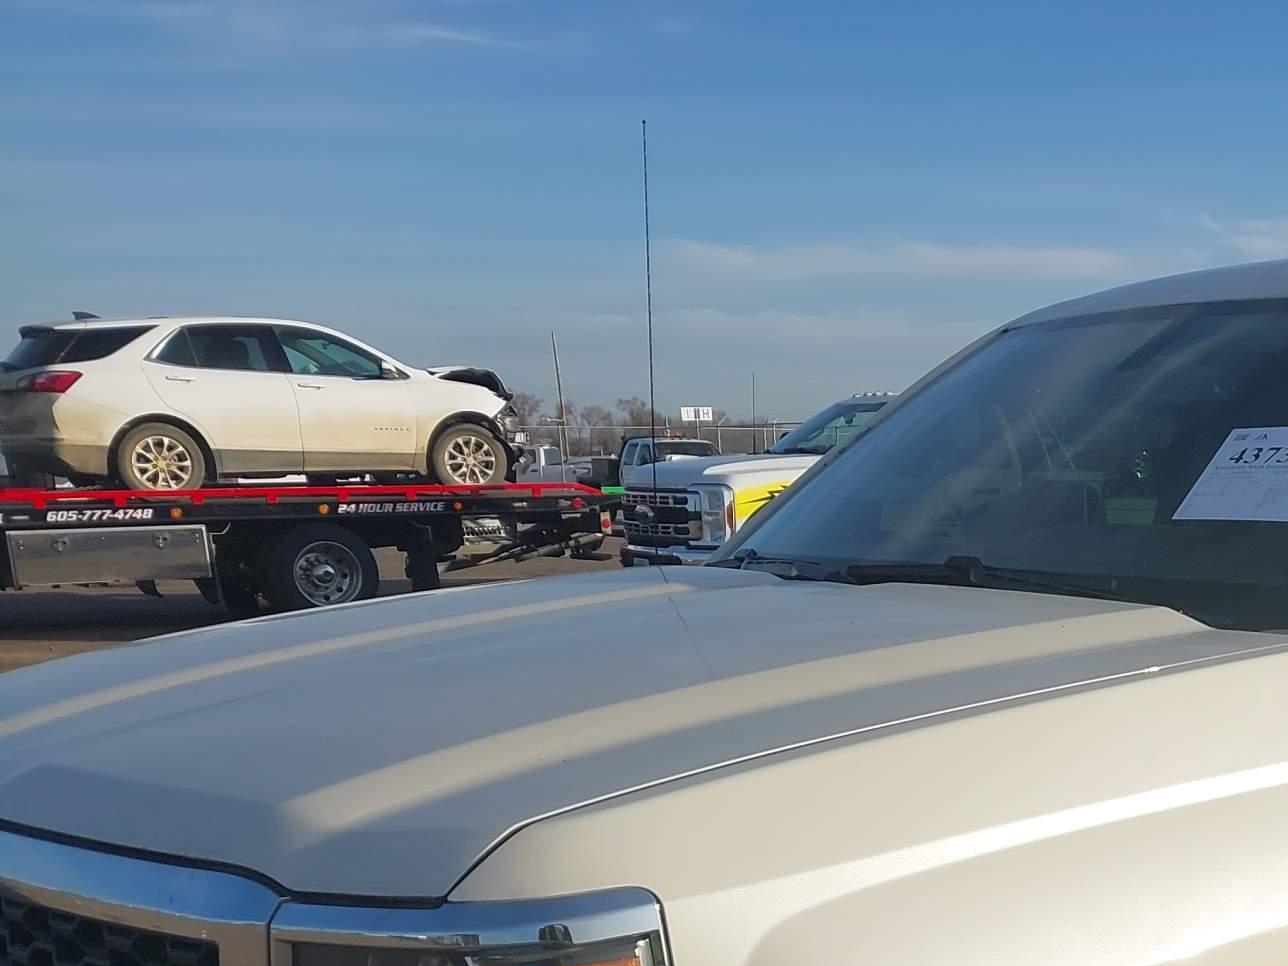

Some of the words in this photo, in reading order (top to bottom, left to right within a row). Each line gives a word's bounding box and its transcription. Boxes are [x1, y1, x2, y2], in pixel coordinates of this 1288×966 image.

[337, 503, 356, 514] 24
[357, 503, 393, 513] HOUR
[395, 501, 445, 512] SERVICE
[46, 508, 154, 522] 605-777-4748
